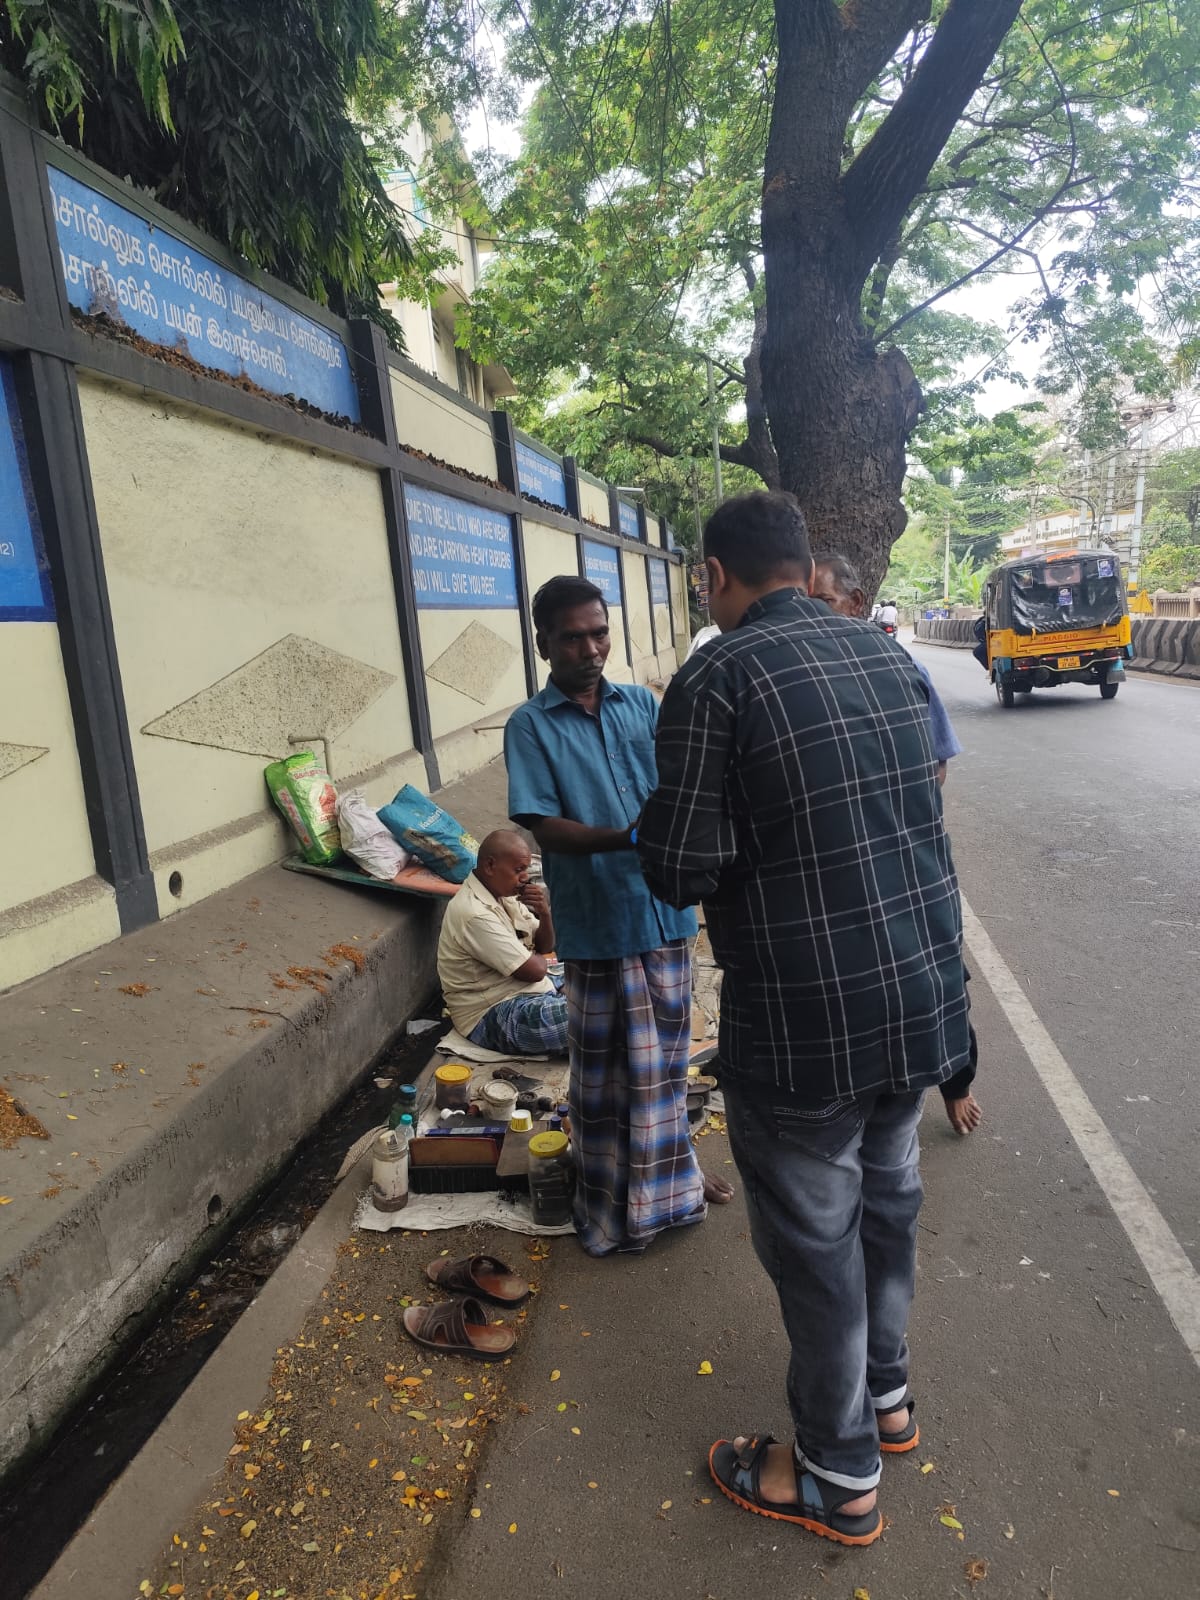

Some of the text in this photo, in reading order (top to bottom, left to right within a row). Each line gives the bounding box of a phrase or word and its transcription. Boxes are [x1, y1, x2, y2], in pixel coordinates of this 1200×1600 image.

[148, 242, 228, 310] சொல்லில்
[229, 289, 289, 340] பயனுடைய
[290, 321, 342, 368] சொல்லற்க
[163, 299, 203, 340] பயன்
[405, 498, 423, 523] OME
[422, 503, 433, 525] TO
[456, 511, 468, 534] YOU
[468, 514, 481, 536] WHO
[482, 519, 494, 540] ARE
[0, 541, 15, 558] 2)
[423, 535, 437, 559] ARE
[437, 539, 470, 563] CARRYING
[470, 546, 489, 566] HEAVY
[412, 567, 427, 592] AND
[430, 569, 451, 593] WILL
[451, 572, 467, 594] GIVE
[467, 574, 481, 595] YOU
[1043, 632, 1079, 641] PIAGGIO
